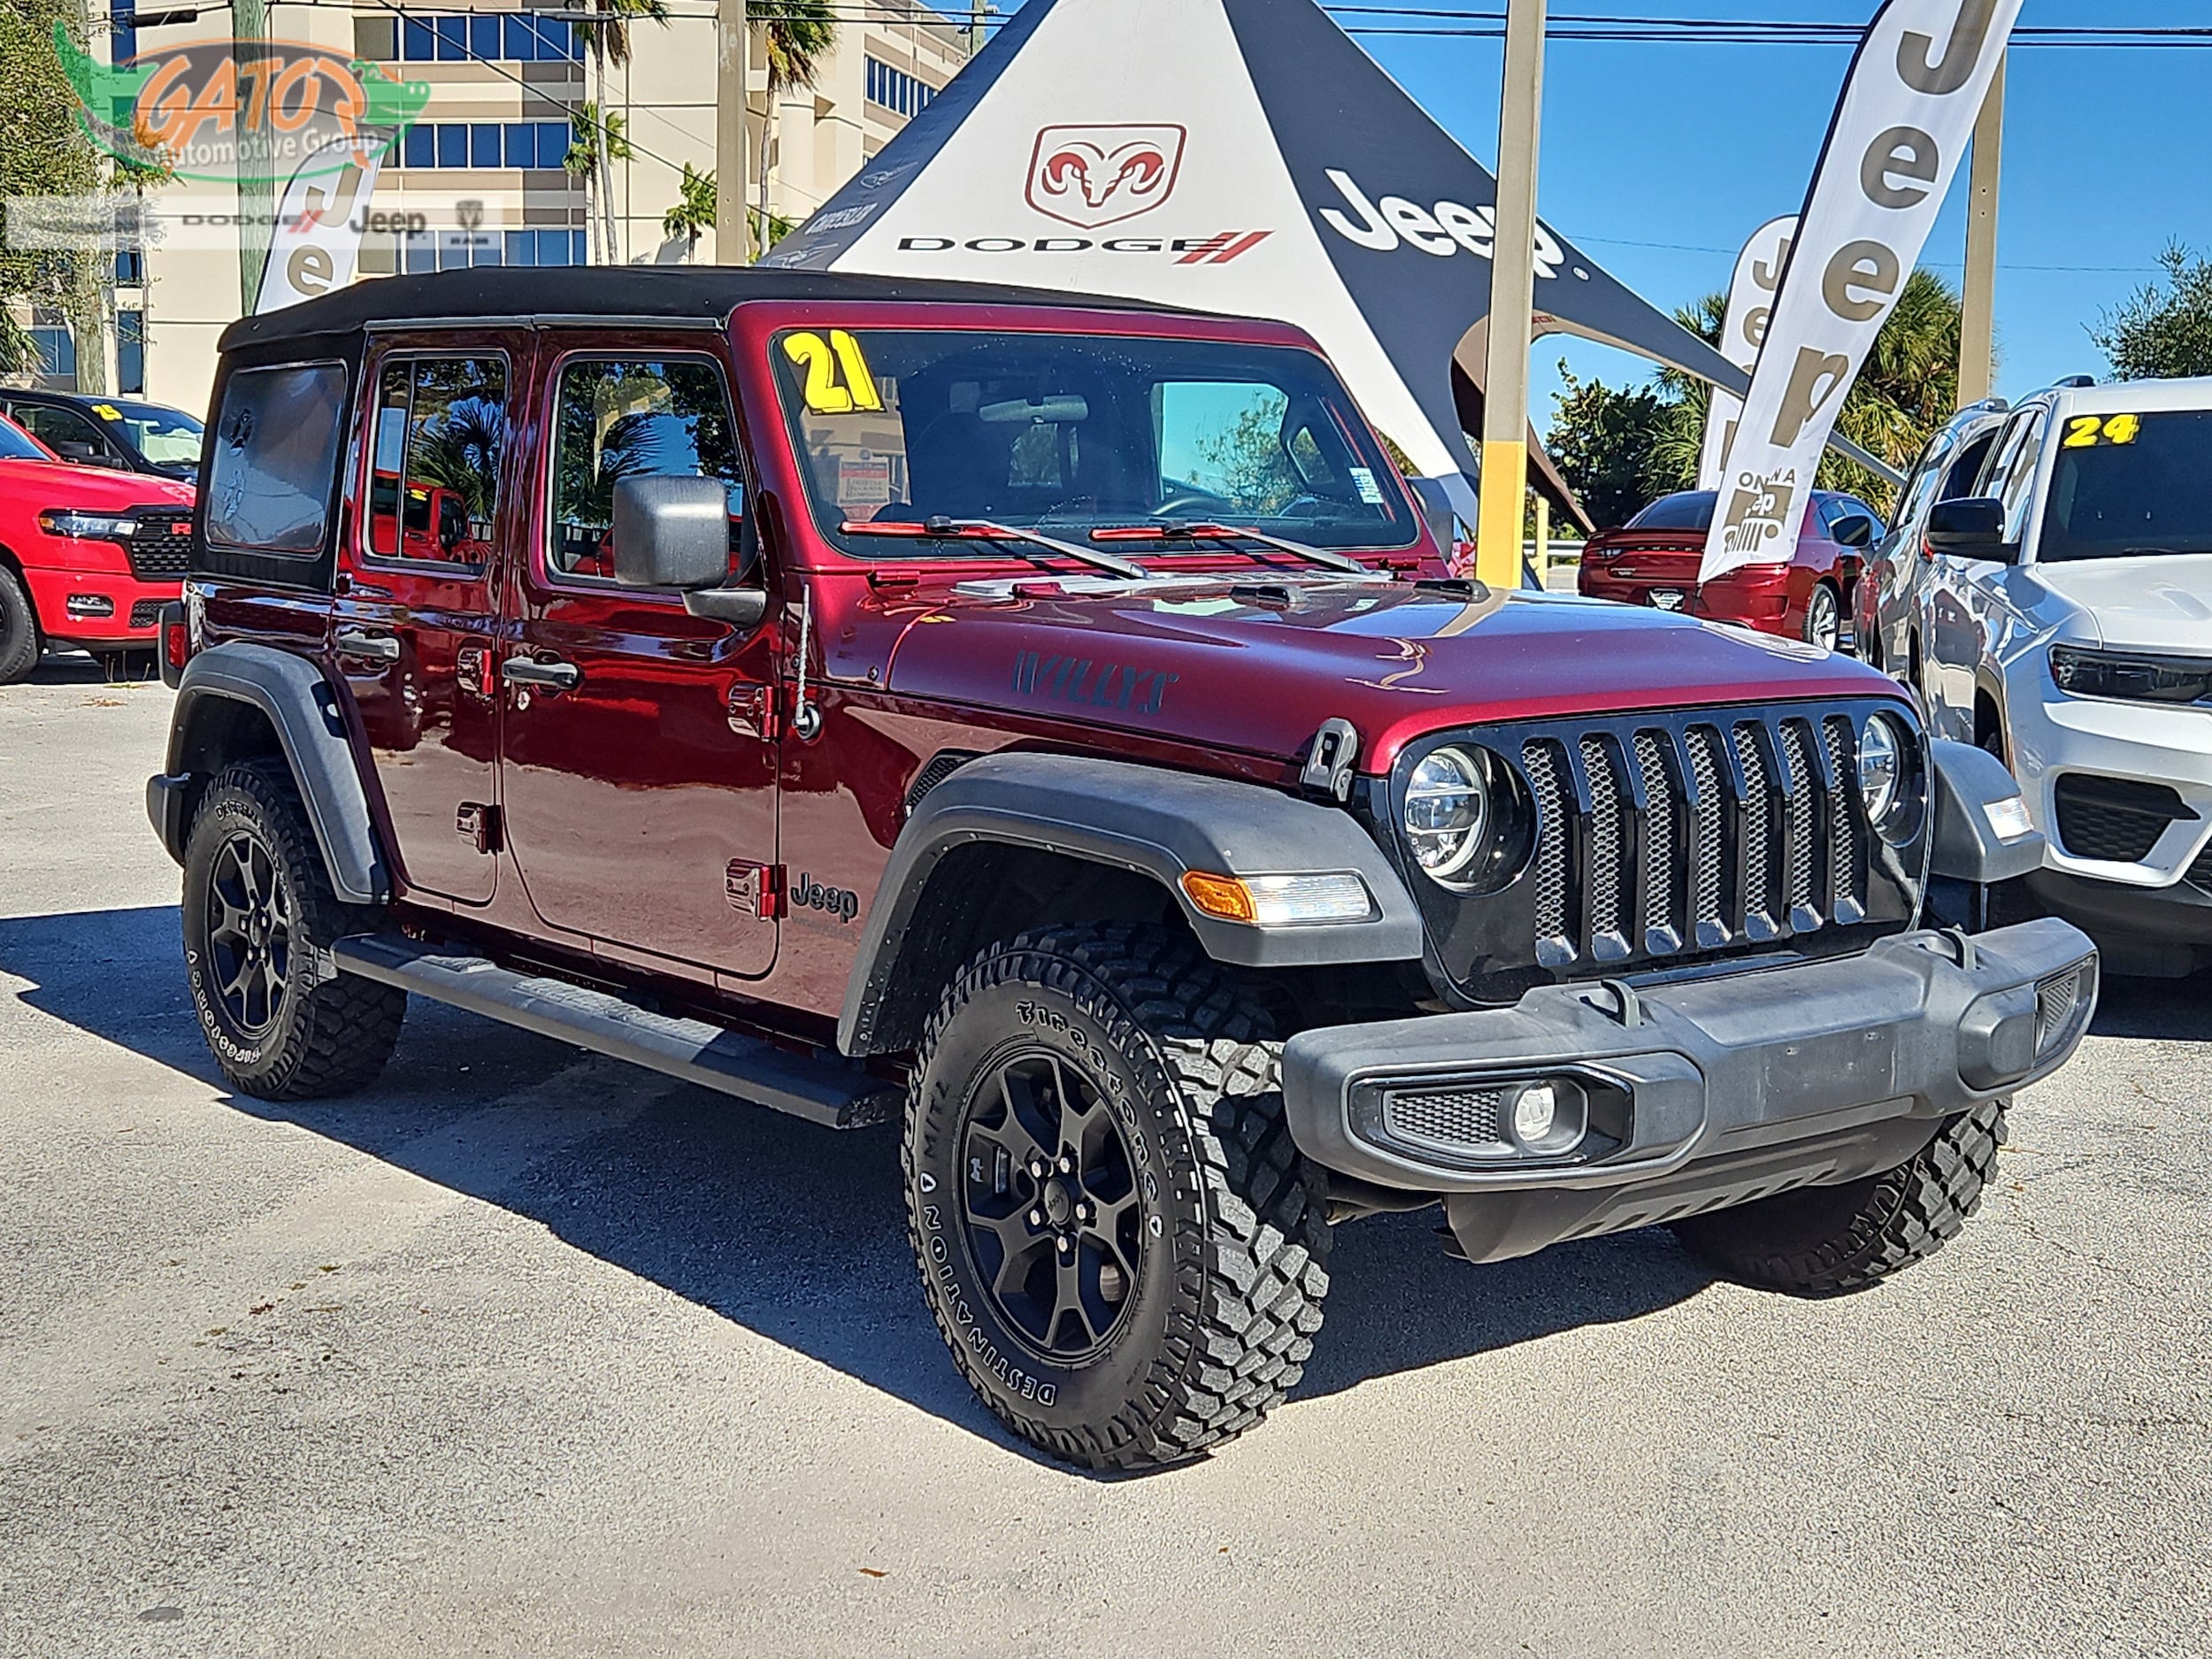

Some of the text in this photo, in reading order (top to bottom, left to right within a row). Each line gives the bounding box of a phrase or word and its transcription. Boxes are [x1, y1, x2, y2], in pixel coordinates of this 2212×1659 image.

[896, 237, 1225, 253] DODGE
[1769, 0, 1998, 449] Jeep
[784, 330, 884, 415] 21
[2063, 414, 2139, 447] 24
[790, 872, 858, 924] Jeep
[923, 1205, 1056, 1407] DESTINATION
